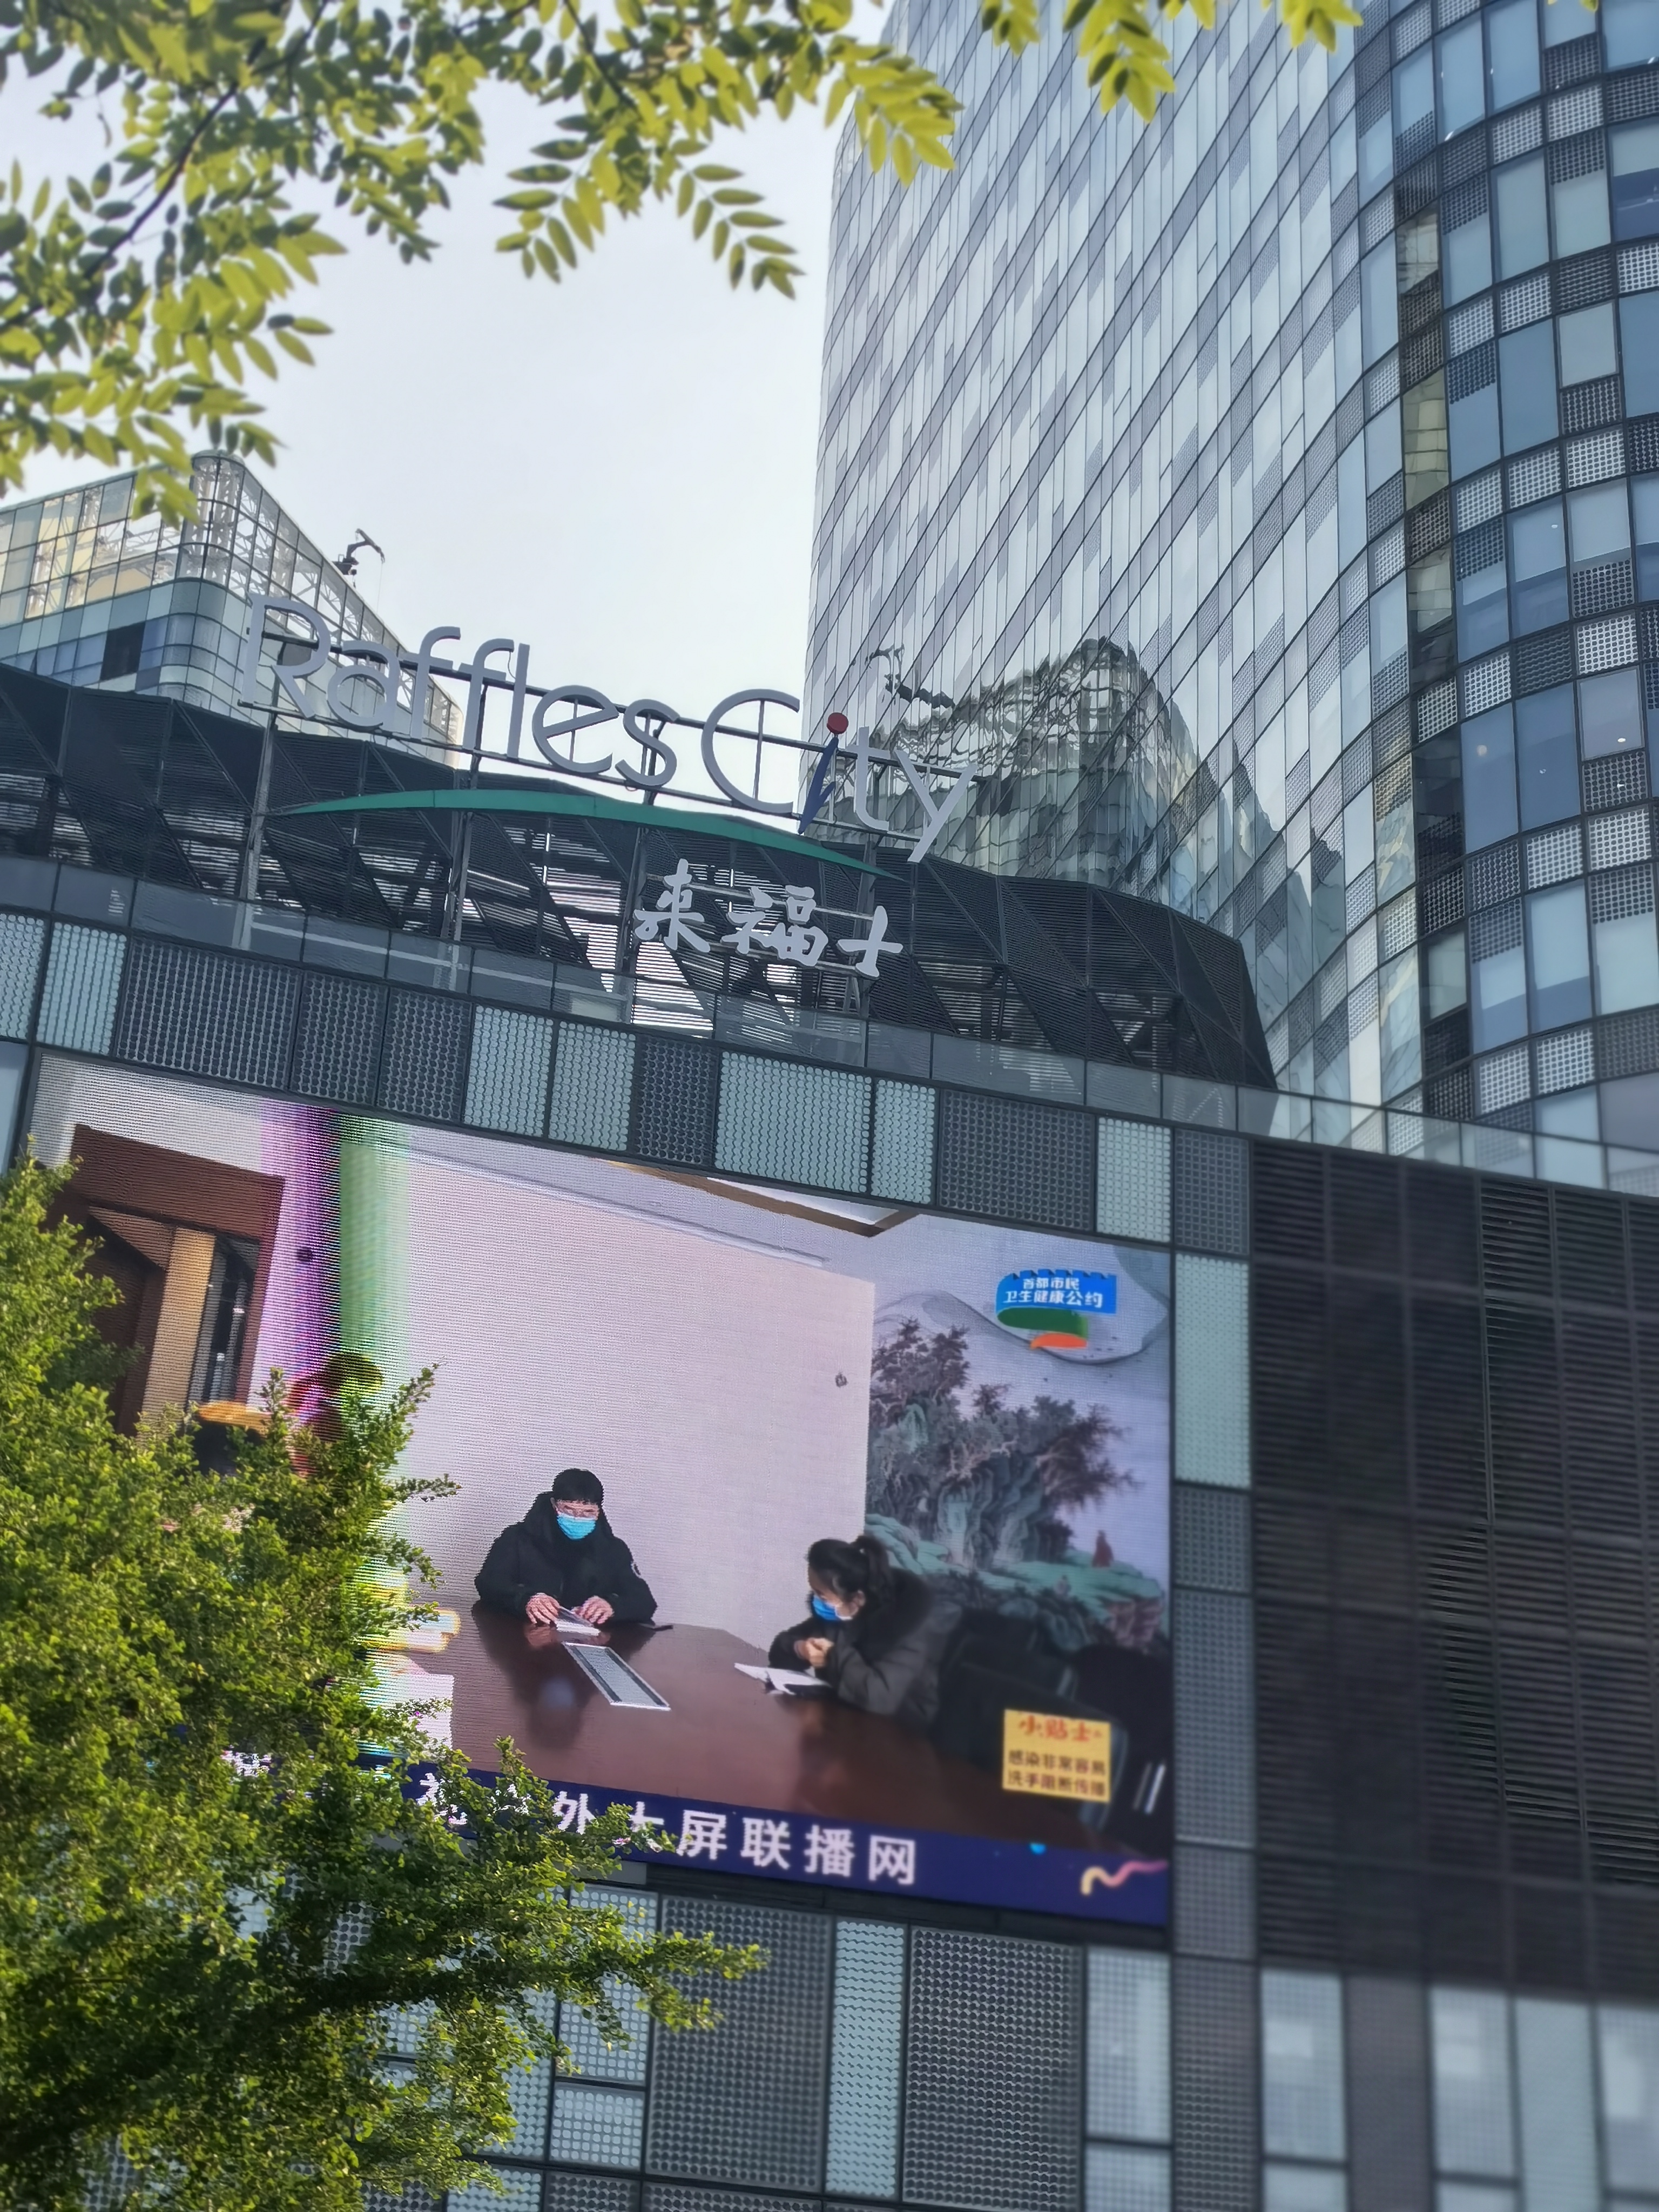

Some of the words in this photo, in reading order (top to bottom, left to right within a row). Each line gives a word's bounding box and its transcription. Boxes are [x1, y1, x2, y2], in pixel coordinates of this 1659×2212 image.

[240, 594, 679, 786] Raffles
[701, 689, 977, 862] City
[633, 859, 903, 977] 来福士
[1003, 1290, 1103, 1308] 卫生健康公约
[1022, 1277, 1080, 1290] 首都市民
